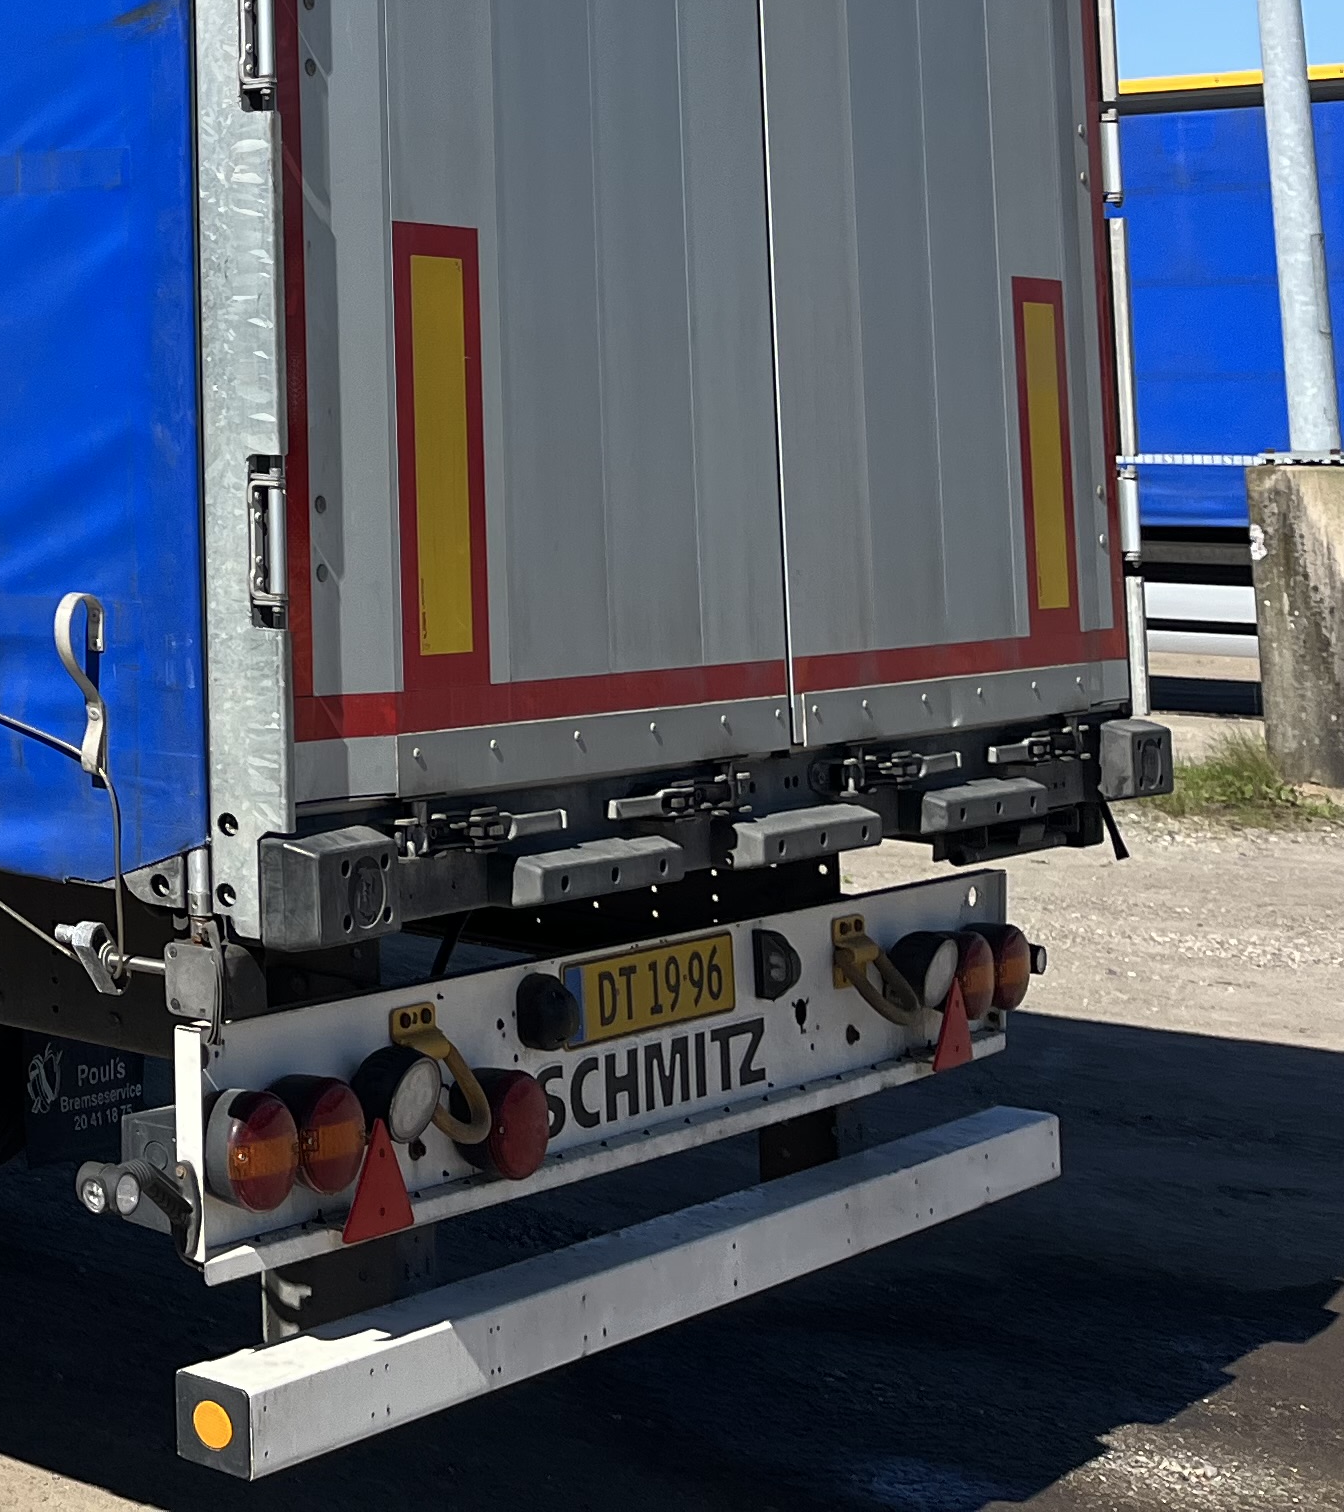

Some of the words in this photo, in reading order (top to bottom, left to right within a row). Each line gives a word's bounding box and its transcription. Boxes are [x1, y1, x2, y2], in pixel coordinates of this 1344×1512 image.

[598, 965, 637, 1027] DT
[60, 1083, 142, 1112] Bremseservice
[536, 1017, 766, 1138] SCHMITZ
[74, 1115, 87, 1131] 20
[90, 1112, 102, 1127] 41
[106, 1108, 119, 1124] 18
